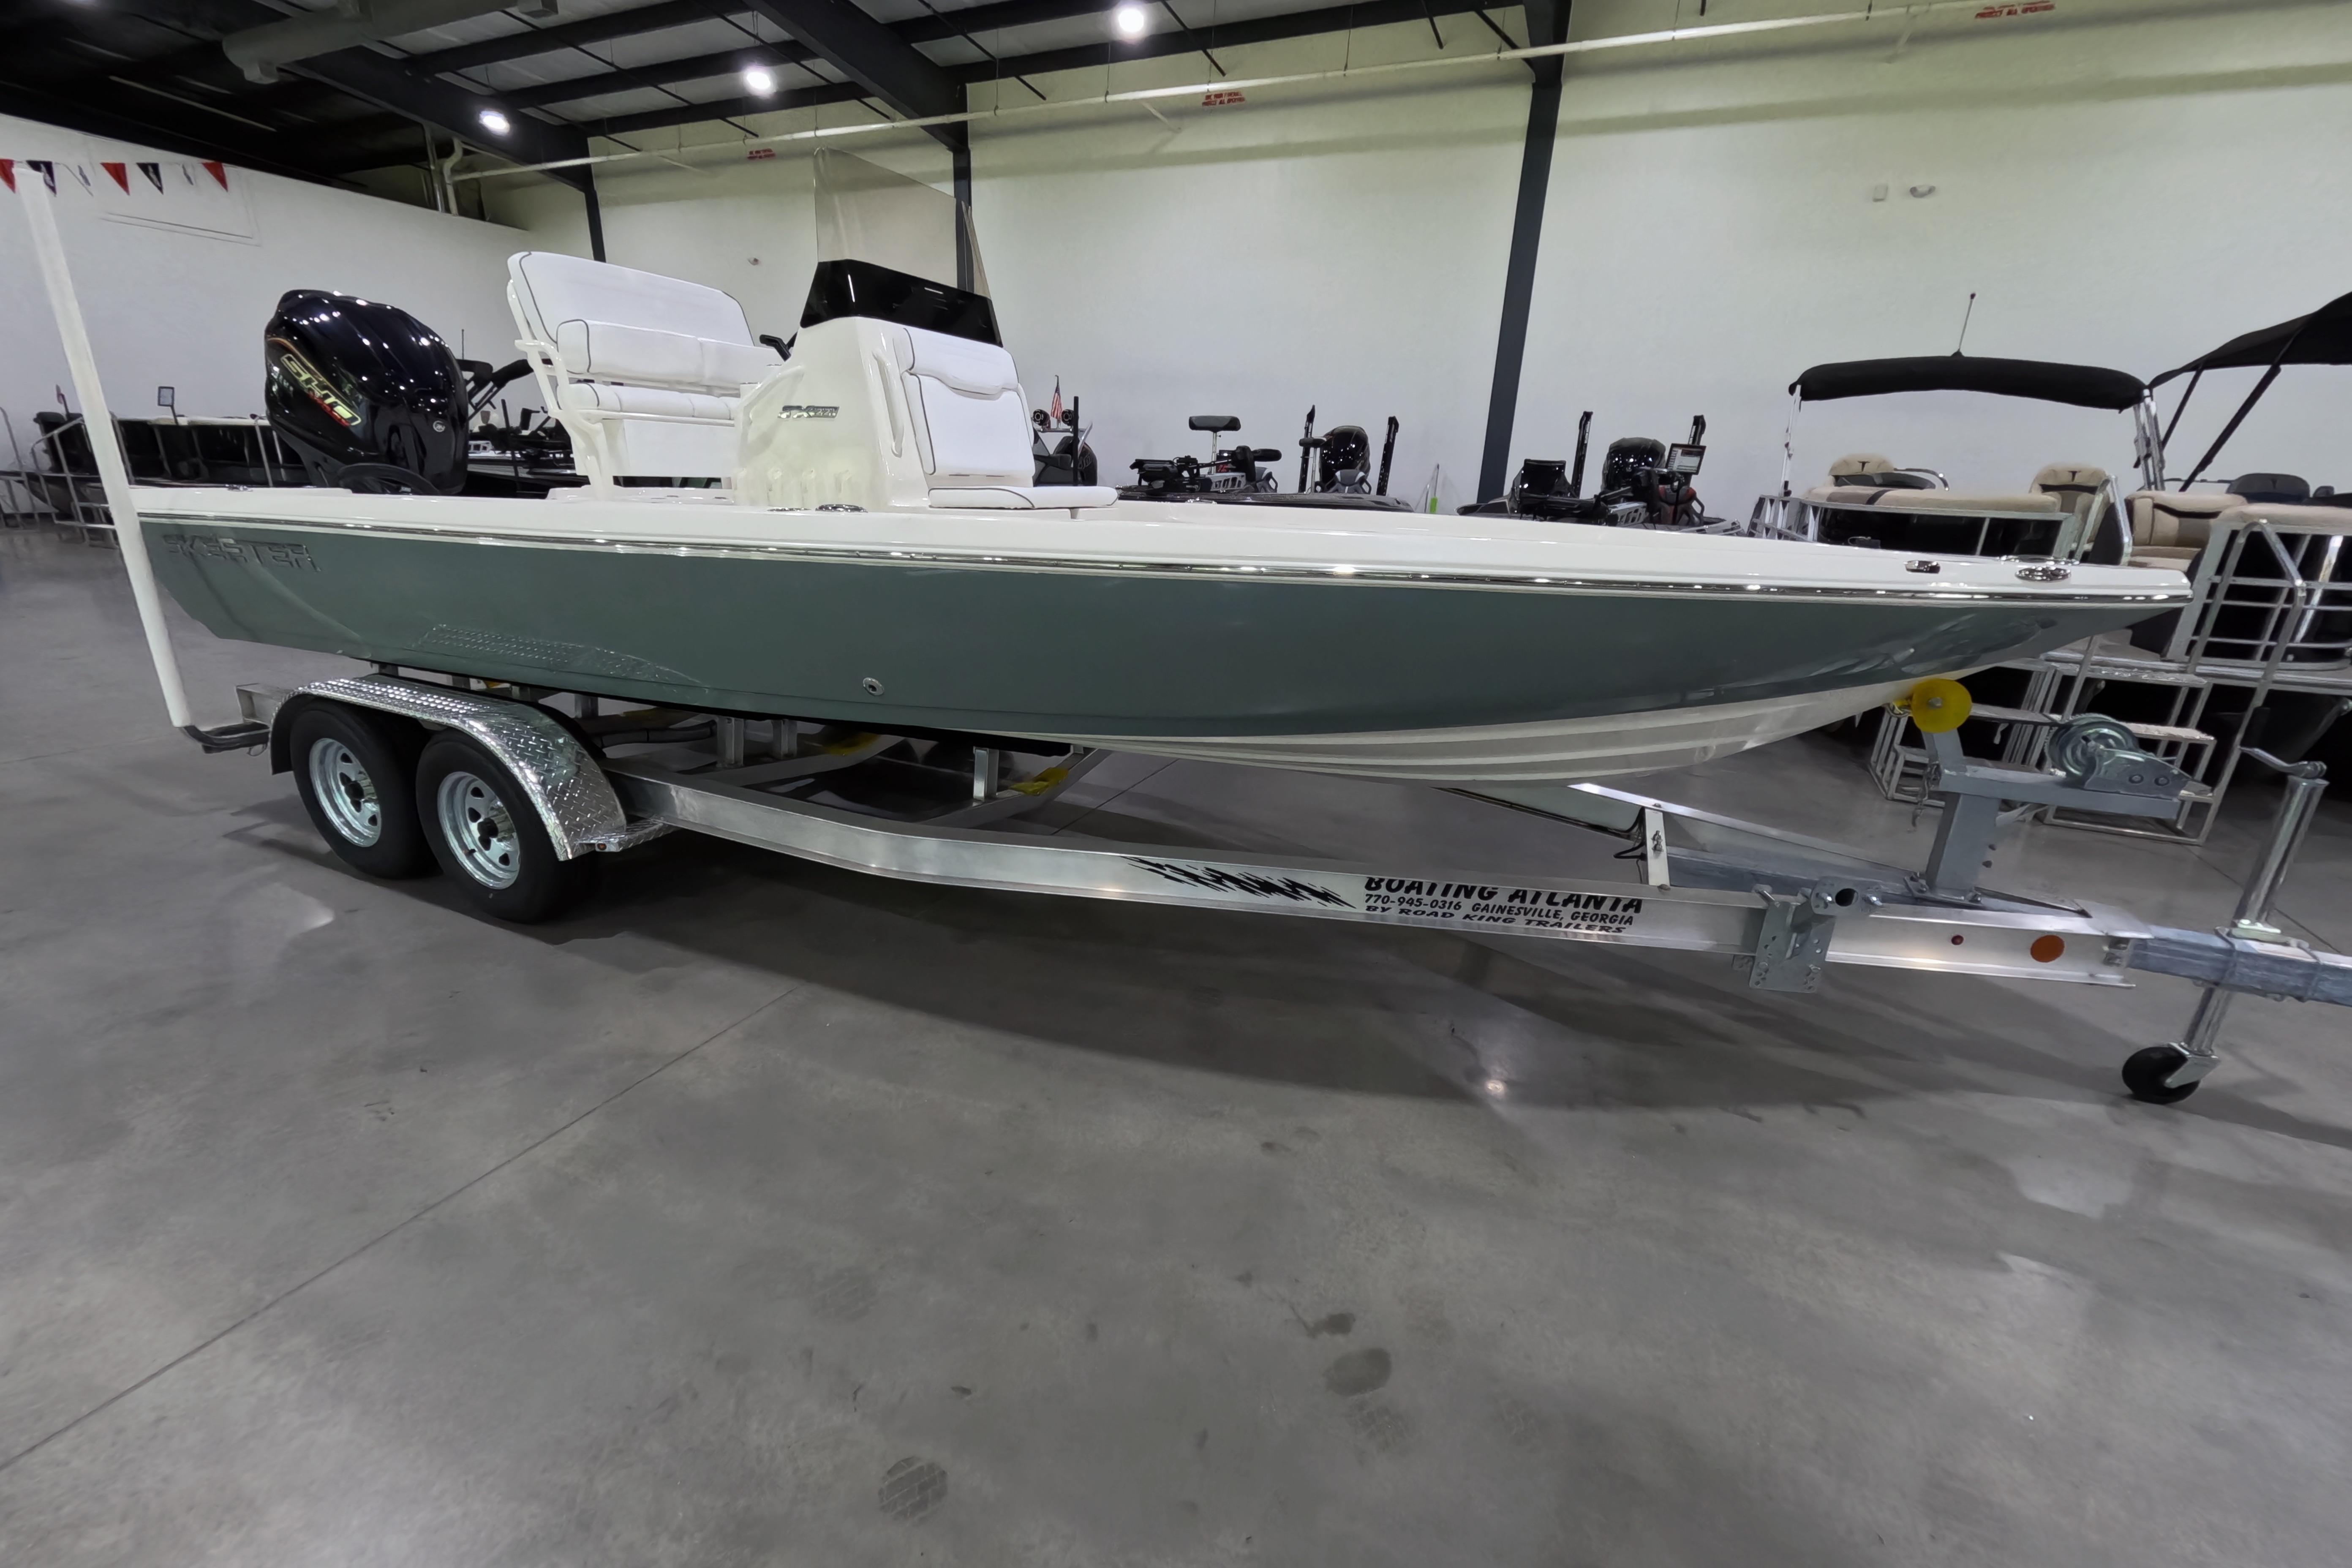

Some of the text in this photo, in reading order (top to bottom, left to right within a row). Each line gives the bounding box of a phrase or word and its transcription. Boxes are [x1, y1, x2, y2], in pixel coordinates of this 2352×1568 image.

[162, 534, 321, 572] SKEETER
[1364, 877, 1642, 913] BOATING ATLANTA
[1365, 894, 1633, 926] 770-945-0316 GAINESVILLE, GEORGIA
[1399, 909, 1455, 918] ROAD
[1462, 914, 1516, 924] KING
[1524, 919, 1626, 933] TRAILERS
